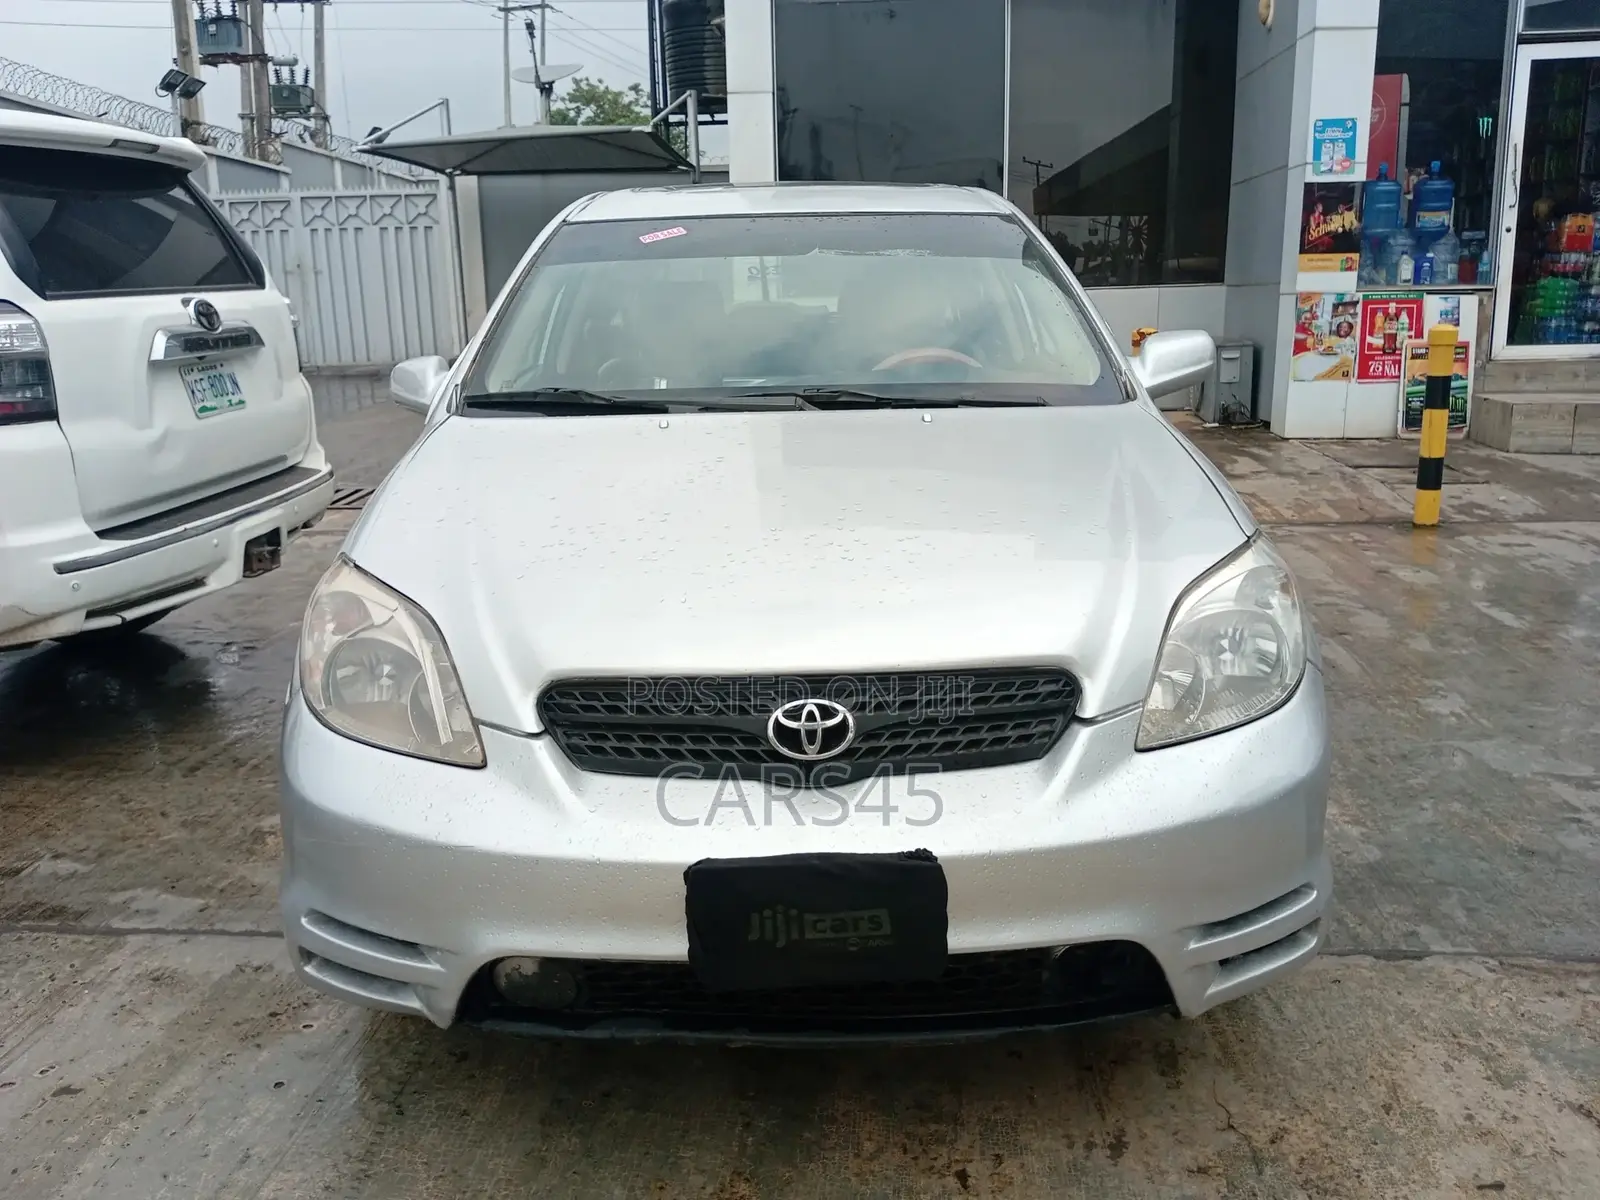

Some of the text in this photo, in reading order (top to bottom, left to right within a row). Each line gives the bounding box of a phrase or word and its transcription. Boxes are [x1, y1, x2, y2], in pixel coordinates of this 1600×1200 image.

[642, 228, 684, 242] FOR SALE
[810, 912, 886, 935] cars
